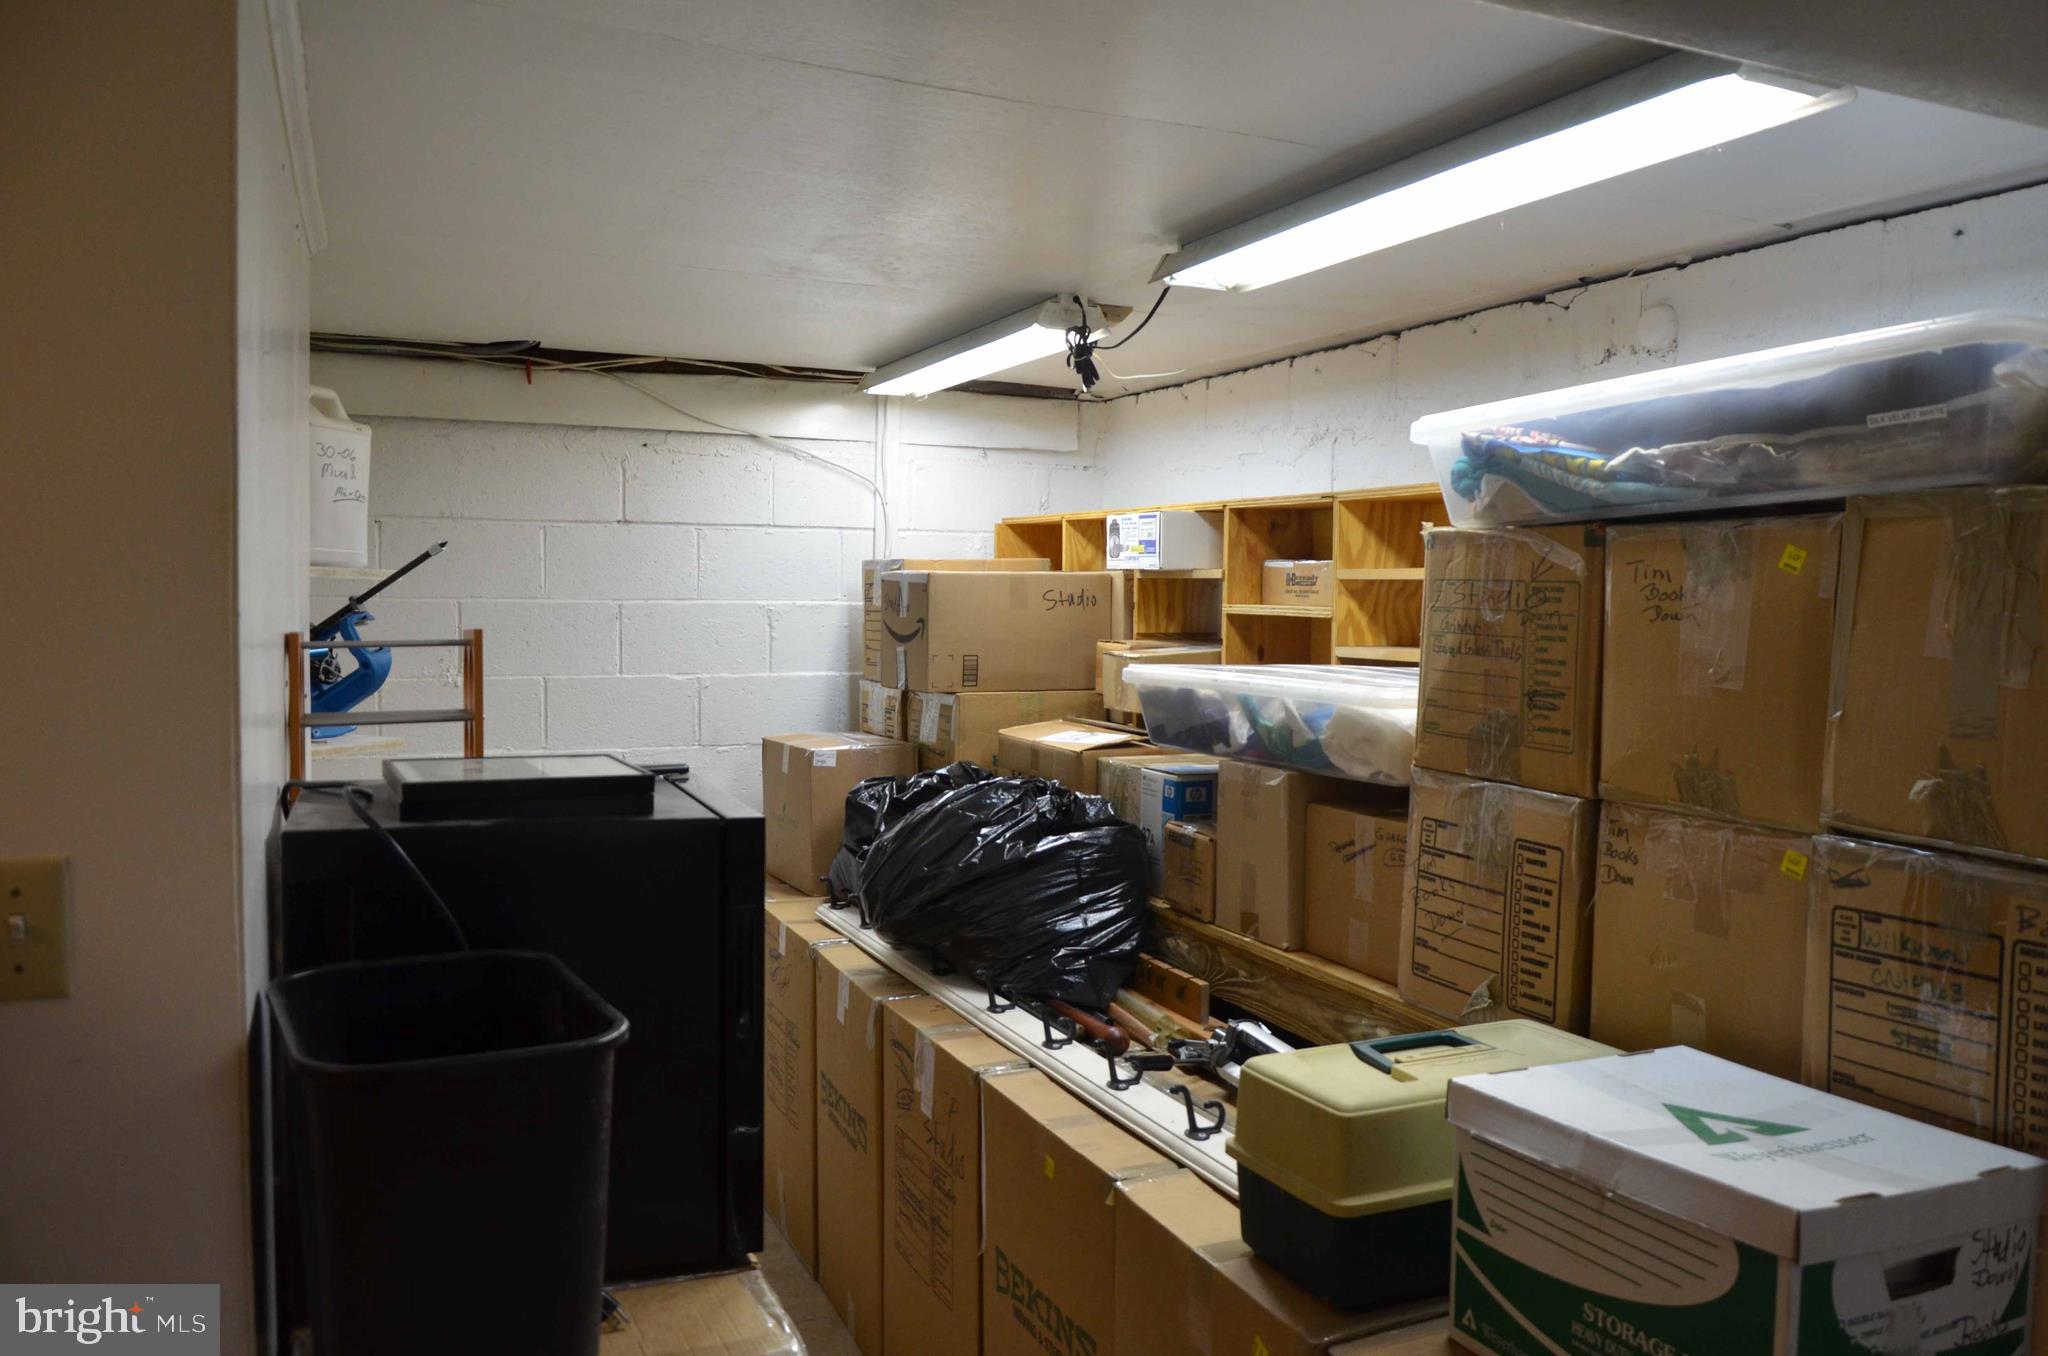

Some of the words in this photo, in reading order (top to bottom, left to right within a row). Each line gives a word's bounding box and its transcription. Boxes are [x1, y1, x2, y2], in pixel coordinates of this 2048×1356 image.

[1626, 559, 1672, 584] Tim
[1042, 588, 1098, 612] Studio
[1608, 819, 1630, 842] Tim
[1603, 841, 1639, 865] Books
[1602, 865, 1634, 886] Down
[820, 1071, 868, 1154] BEKINS
[1971, 1224, 2027, 1265] Studio
[994, 1245, 1098, 1356] BEKINS
[1583, 1301, 1676, 1356] STORAGE
